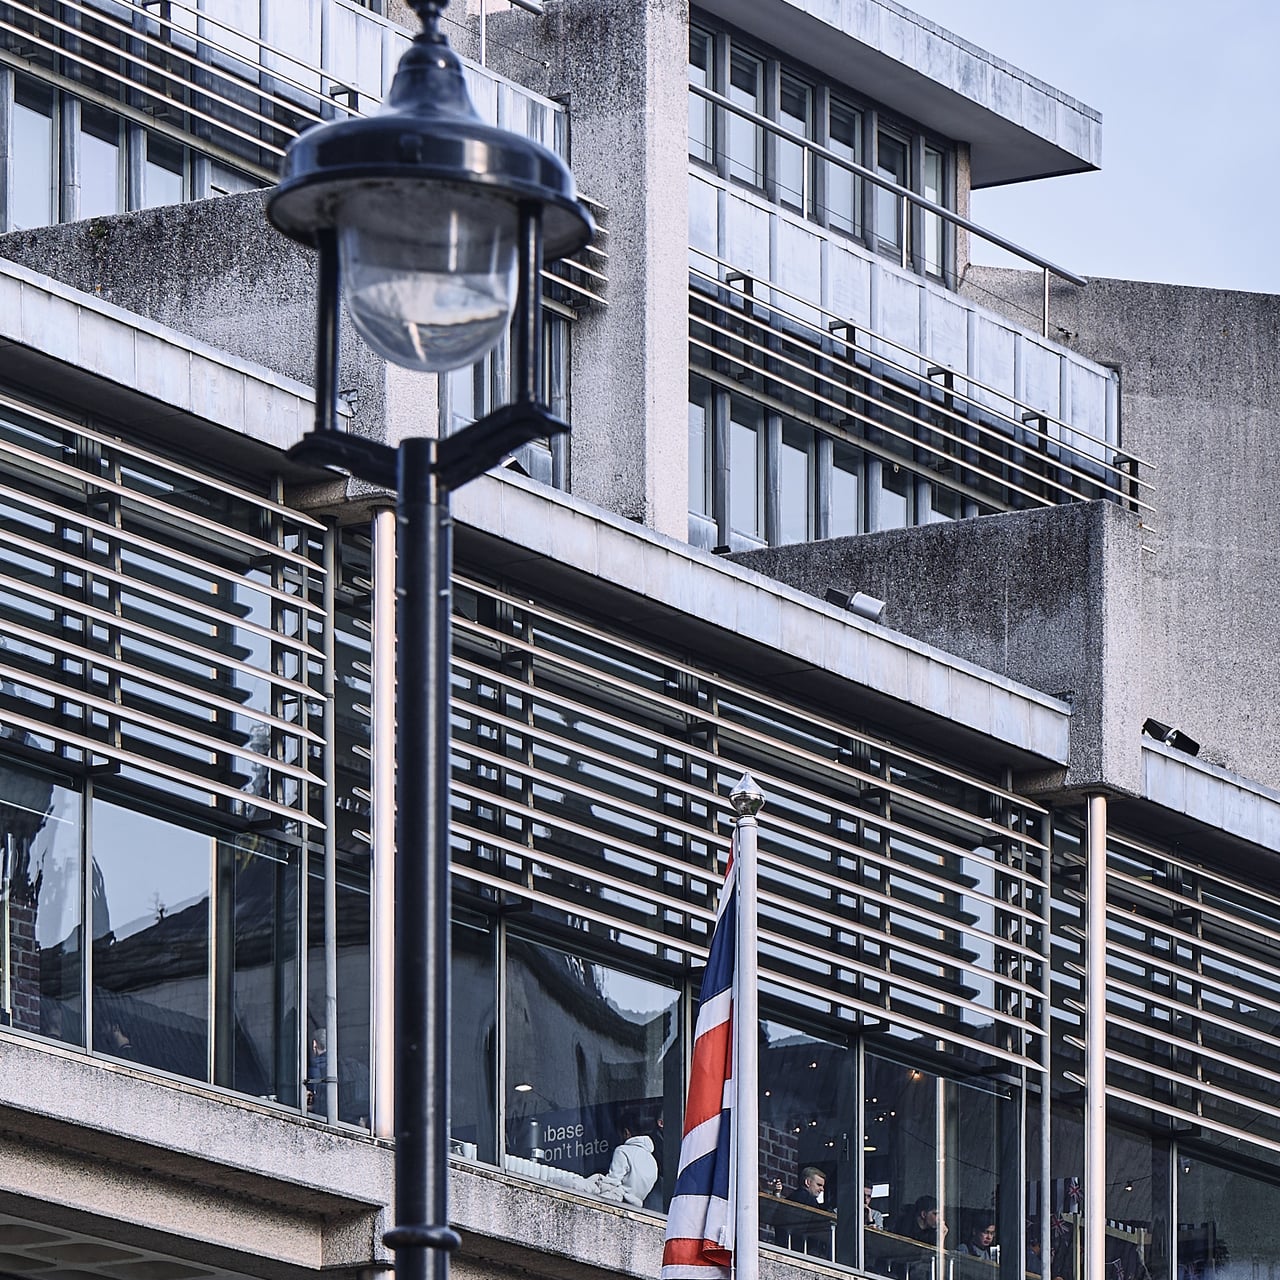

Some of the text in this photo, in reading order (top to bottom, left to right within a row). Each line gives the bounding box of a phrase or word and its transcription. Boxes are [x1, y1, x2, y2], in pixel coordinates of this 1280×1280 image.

[544, 1124, 584, 1142] base
[544, 1139, 609, 1161] on't hate
